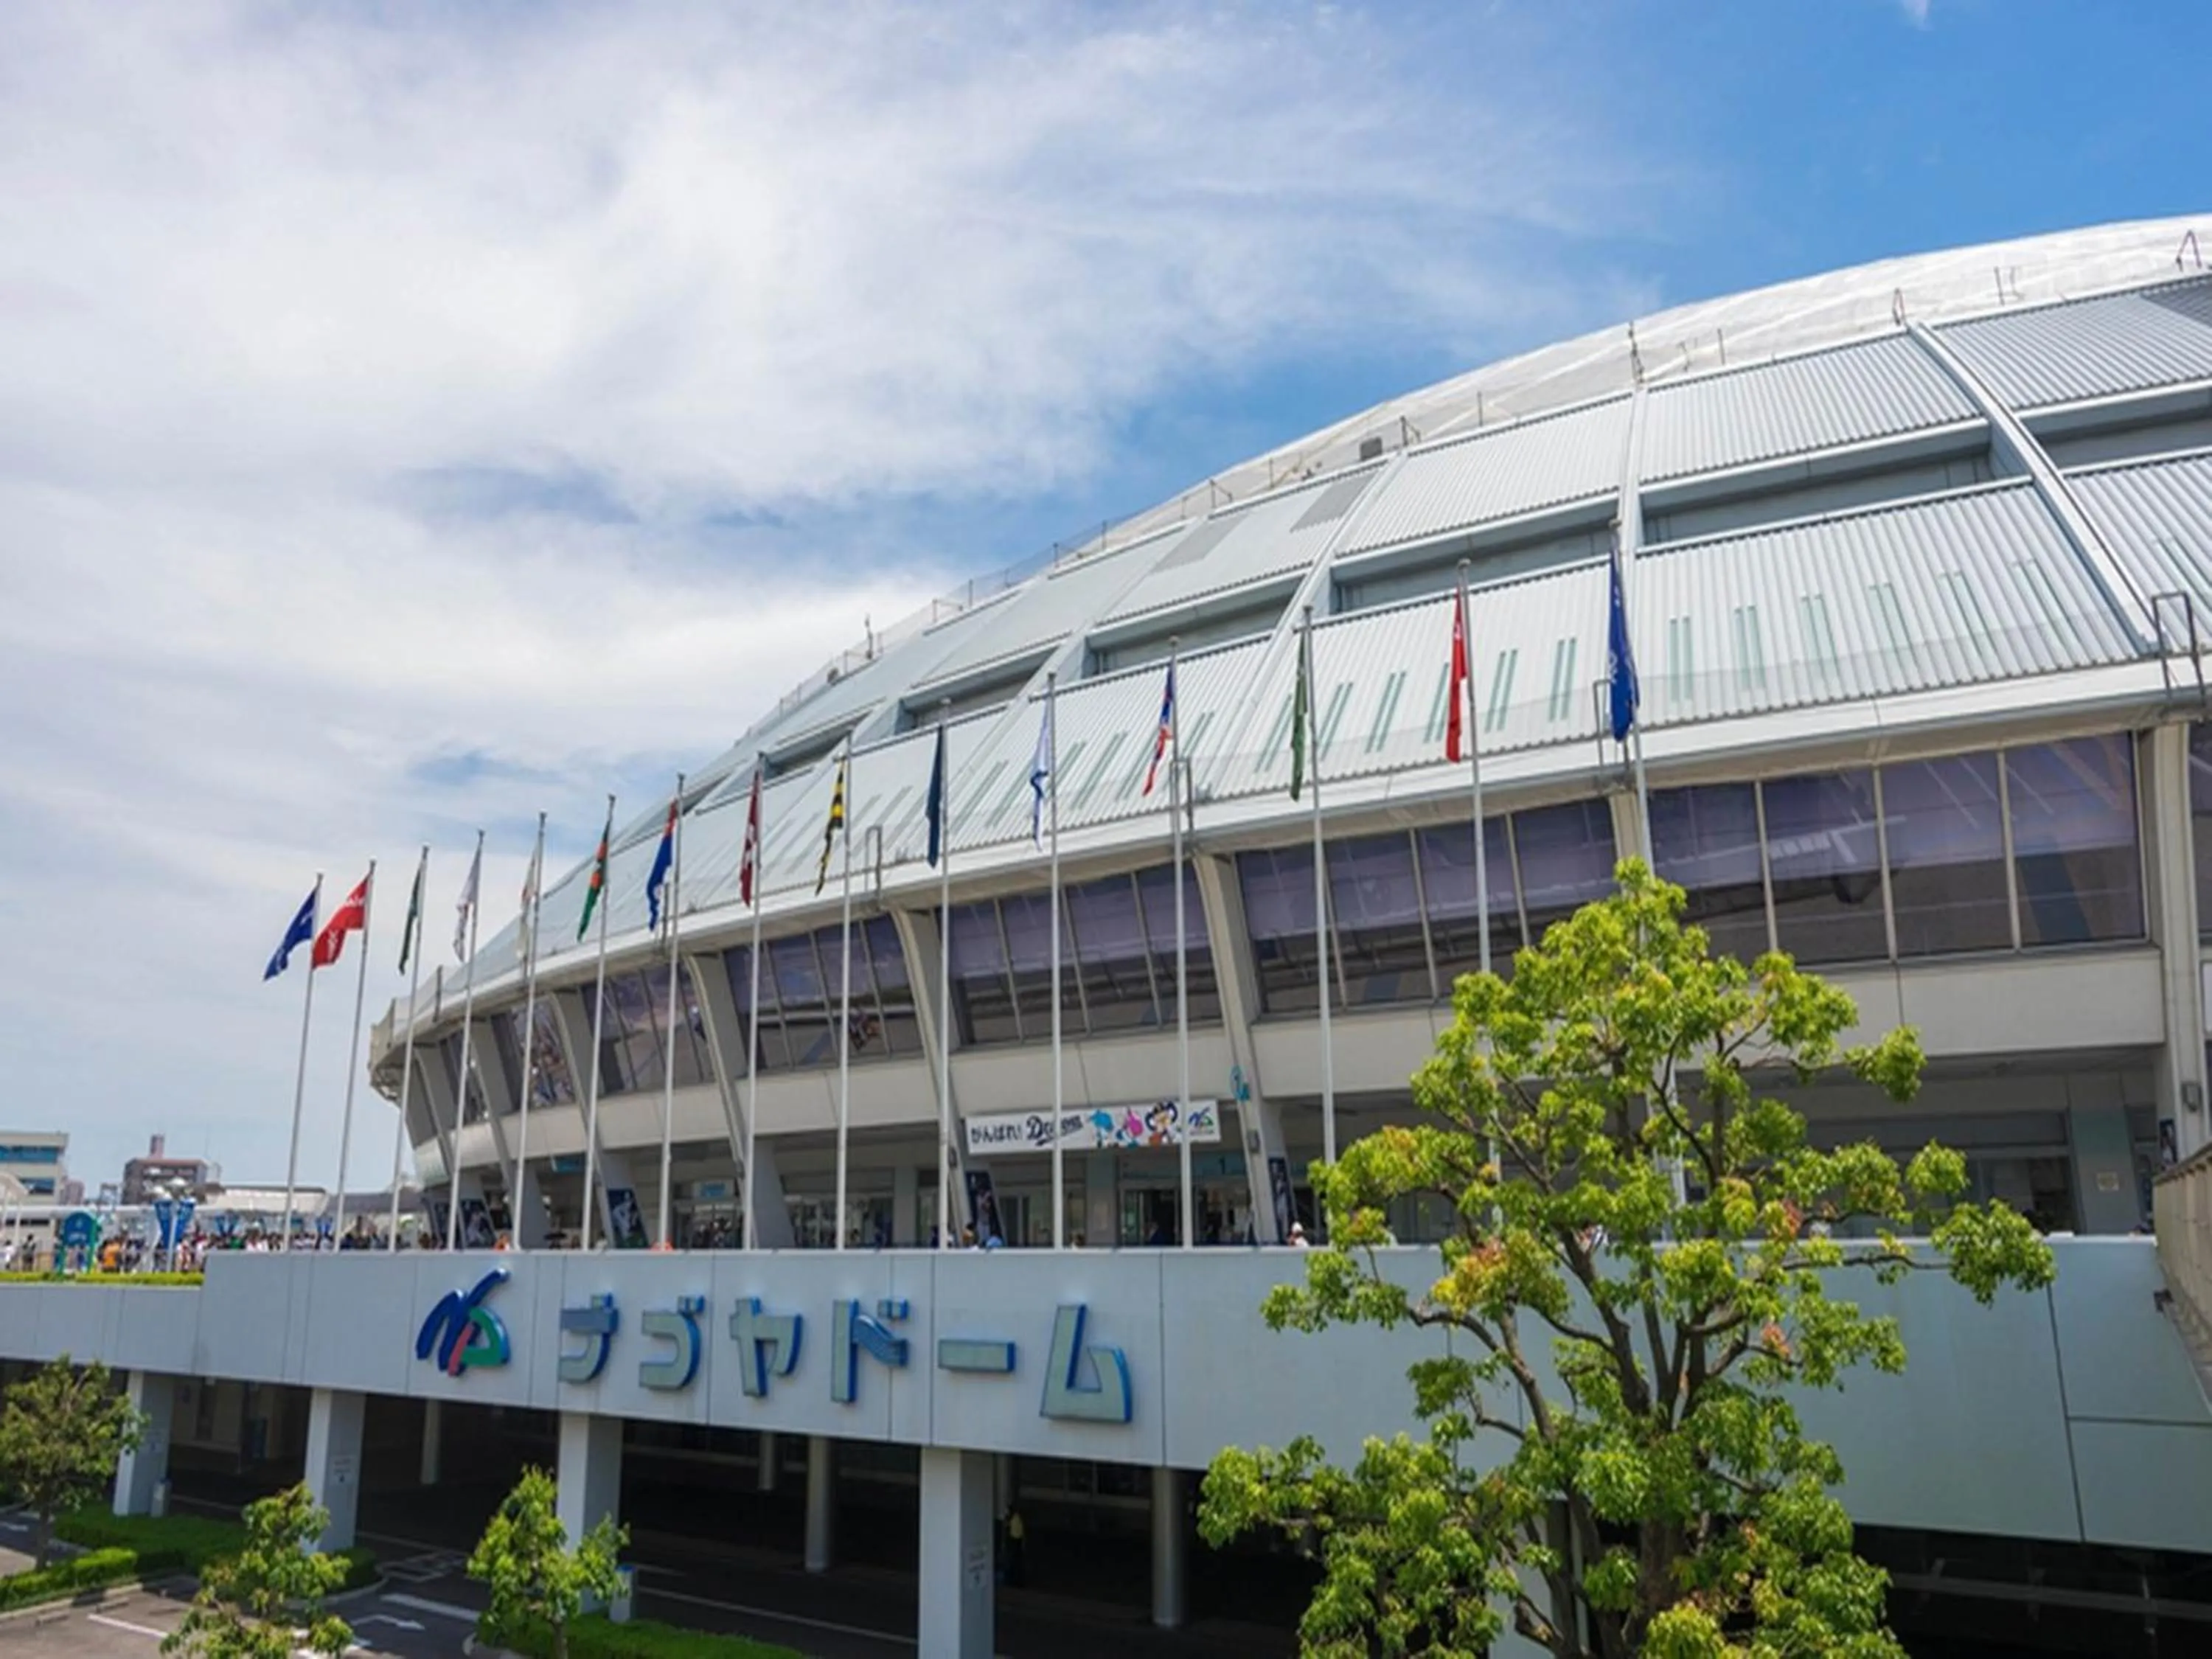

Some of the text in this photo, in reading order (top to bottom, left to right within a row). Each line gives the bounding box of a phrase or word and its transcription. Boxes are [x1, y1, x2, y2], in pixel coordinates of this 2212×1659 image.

[557, 1292, 1133, 1423] ナゴヤドーム
